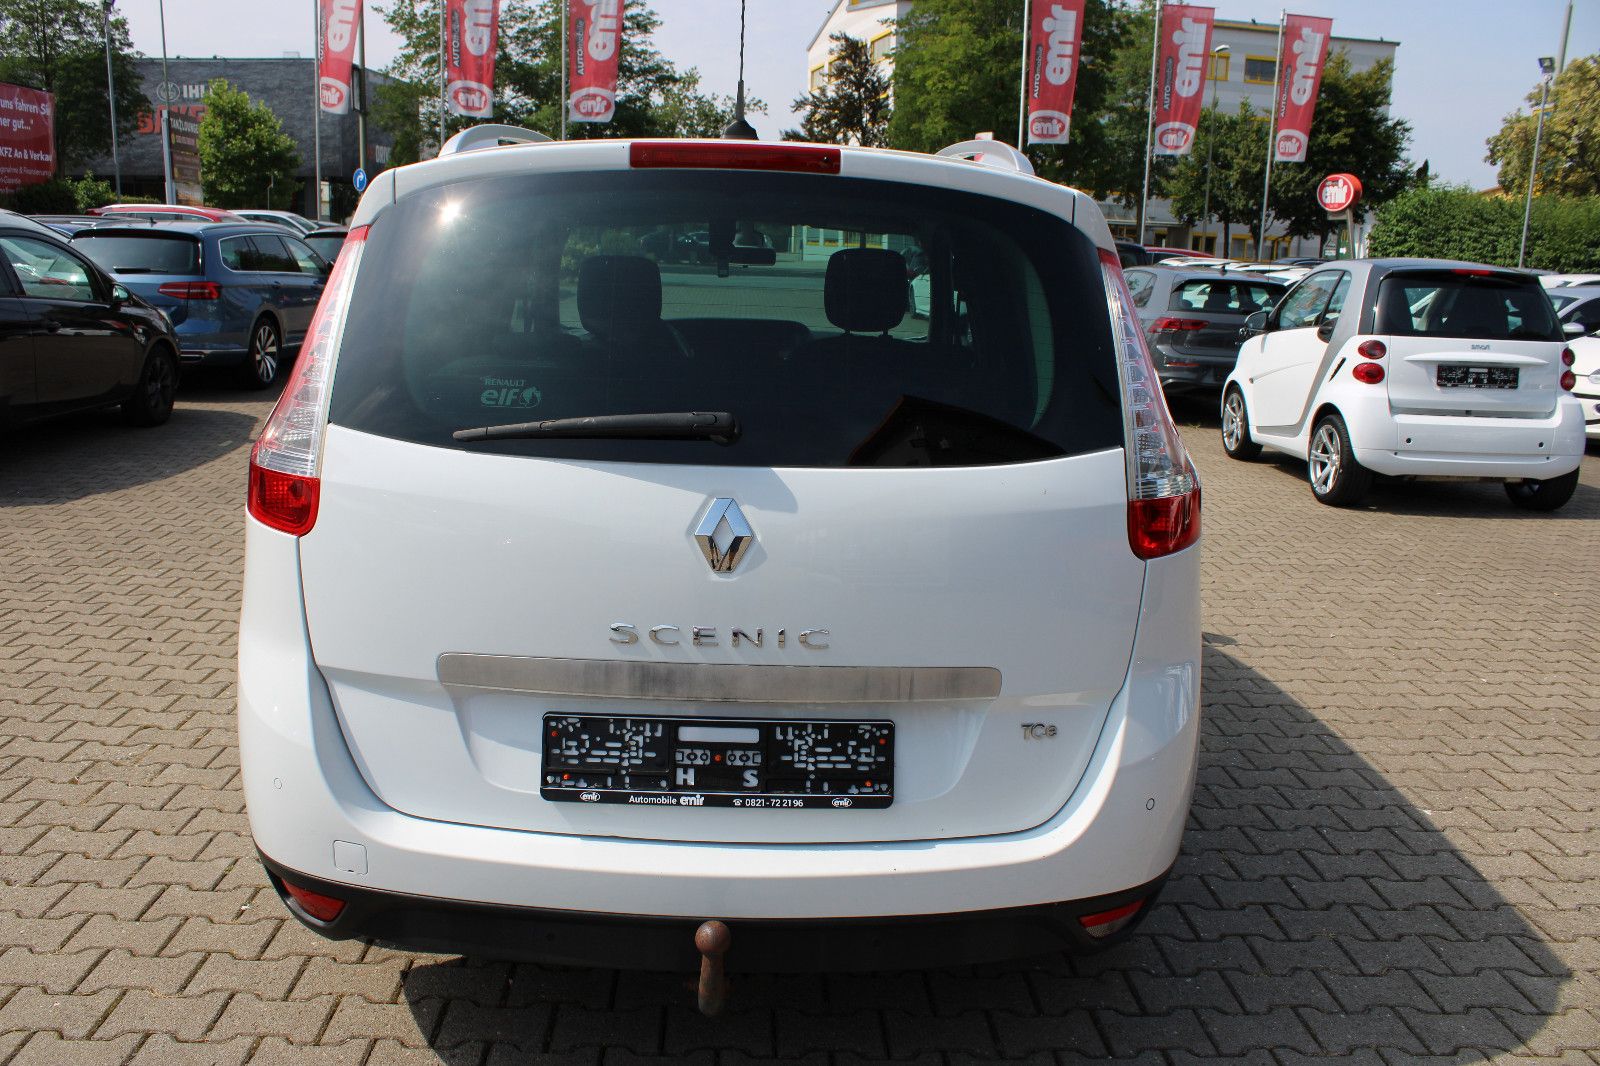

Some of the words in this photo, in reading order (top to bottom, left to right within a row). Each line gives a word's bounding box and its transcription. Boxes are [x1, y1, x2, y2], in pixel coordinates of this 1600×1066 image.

[328, 0, 355, 52] em
[464, 0, 492, 56] em
[1042, 4, 1077, 86] emir
[1172, 17, 1207, 97] emir
[1292, 27, 1324, 106] emir
[15, 98, 38, 113] fahren
[40, 103, 50, 116] Si
[1322, 179, 1348, 204] emir
[481, 388, 519, 406] elf
[609, 622, 830, 649] SCENIC
[581, 792, 599, 801] emir
[629, 795, 677, 805] Automobile
[680, 794, 705, 806] emir
[833, 798, 851, 807] emir
